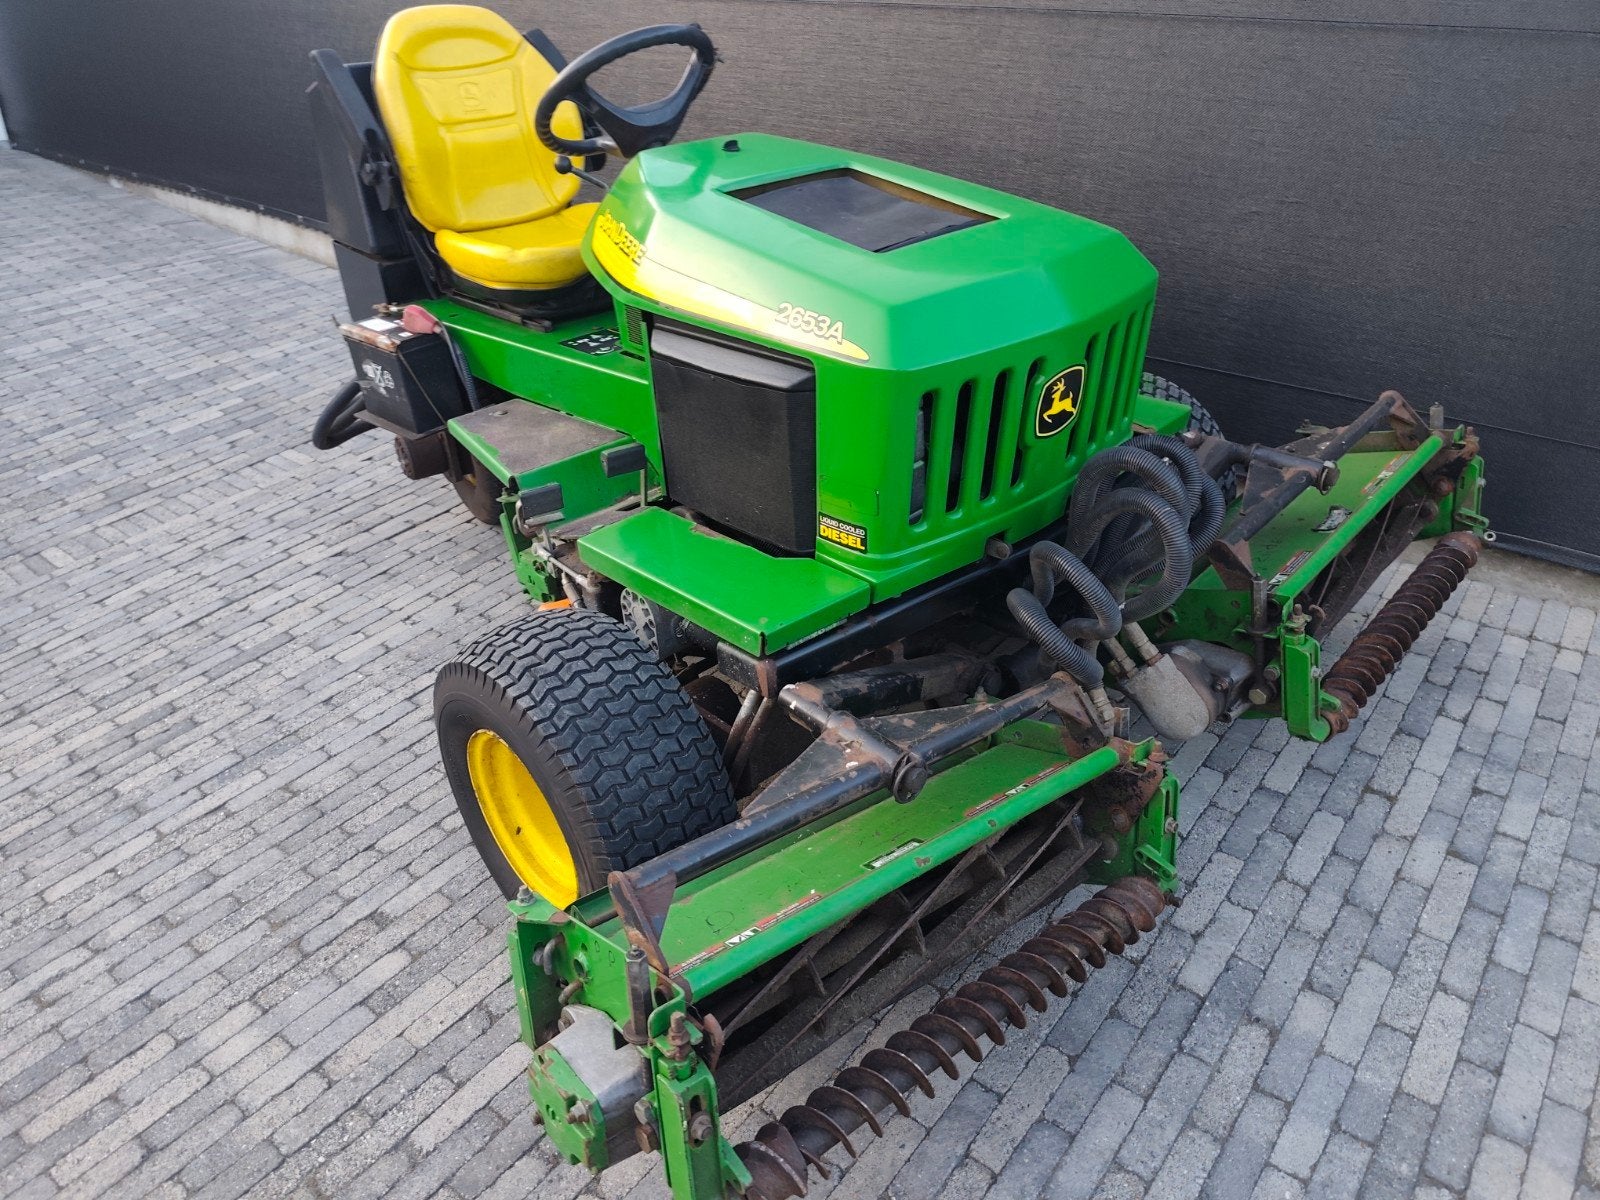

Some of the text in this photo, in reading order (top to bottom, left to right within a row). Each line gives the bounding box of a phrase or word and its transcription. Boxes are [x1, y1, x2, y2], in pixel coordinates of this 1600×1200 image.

[615, 222, 646, 266] DEERE
[776, 301, 844, 345] 2653A
[820, 516, 865, 535] LIQUID COOLED
[820, 525, 865, 549] DIESEL
